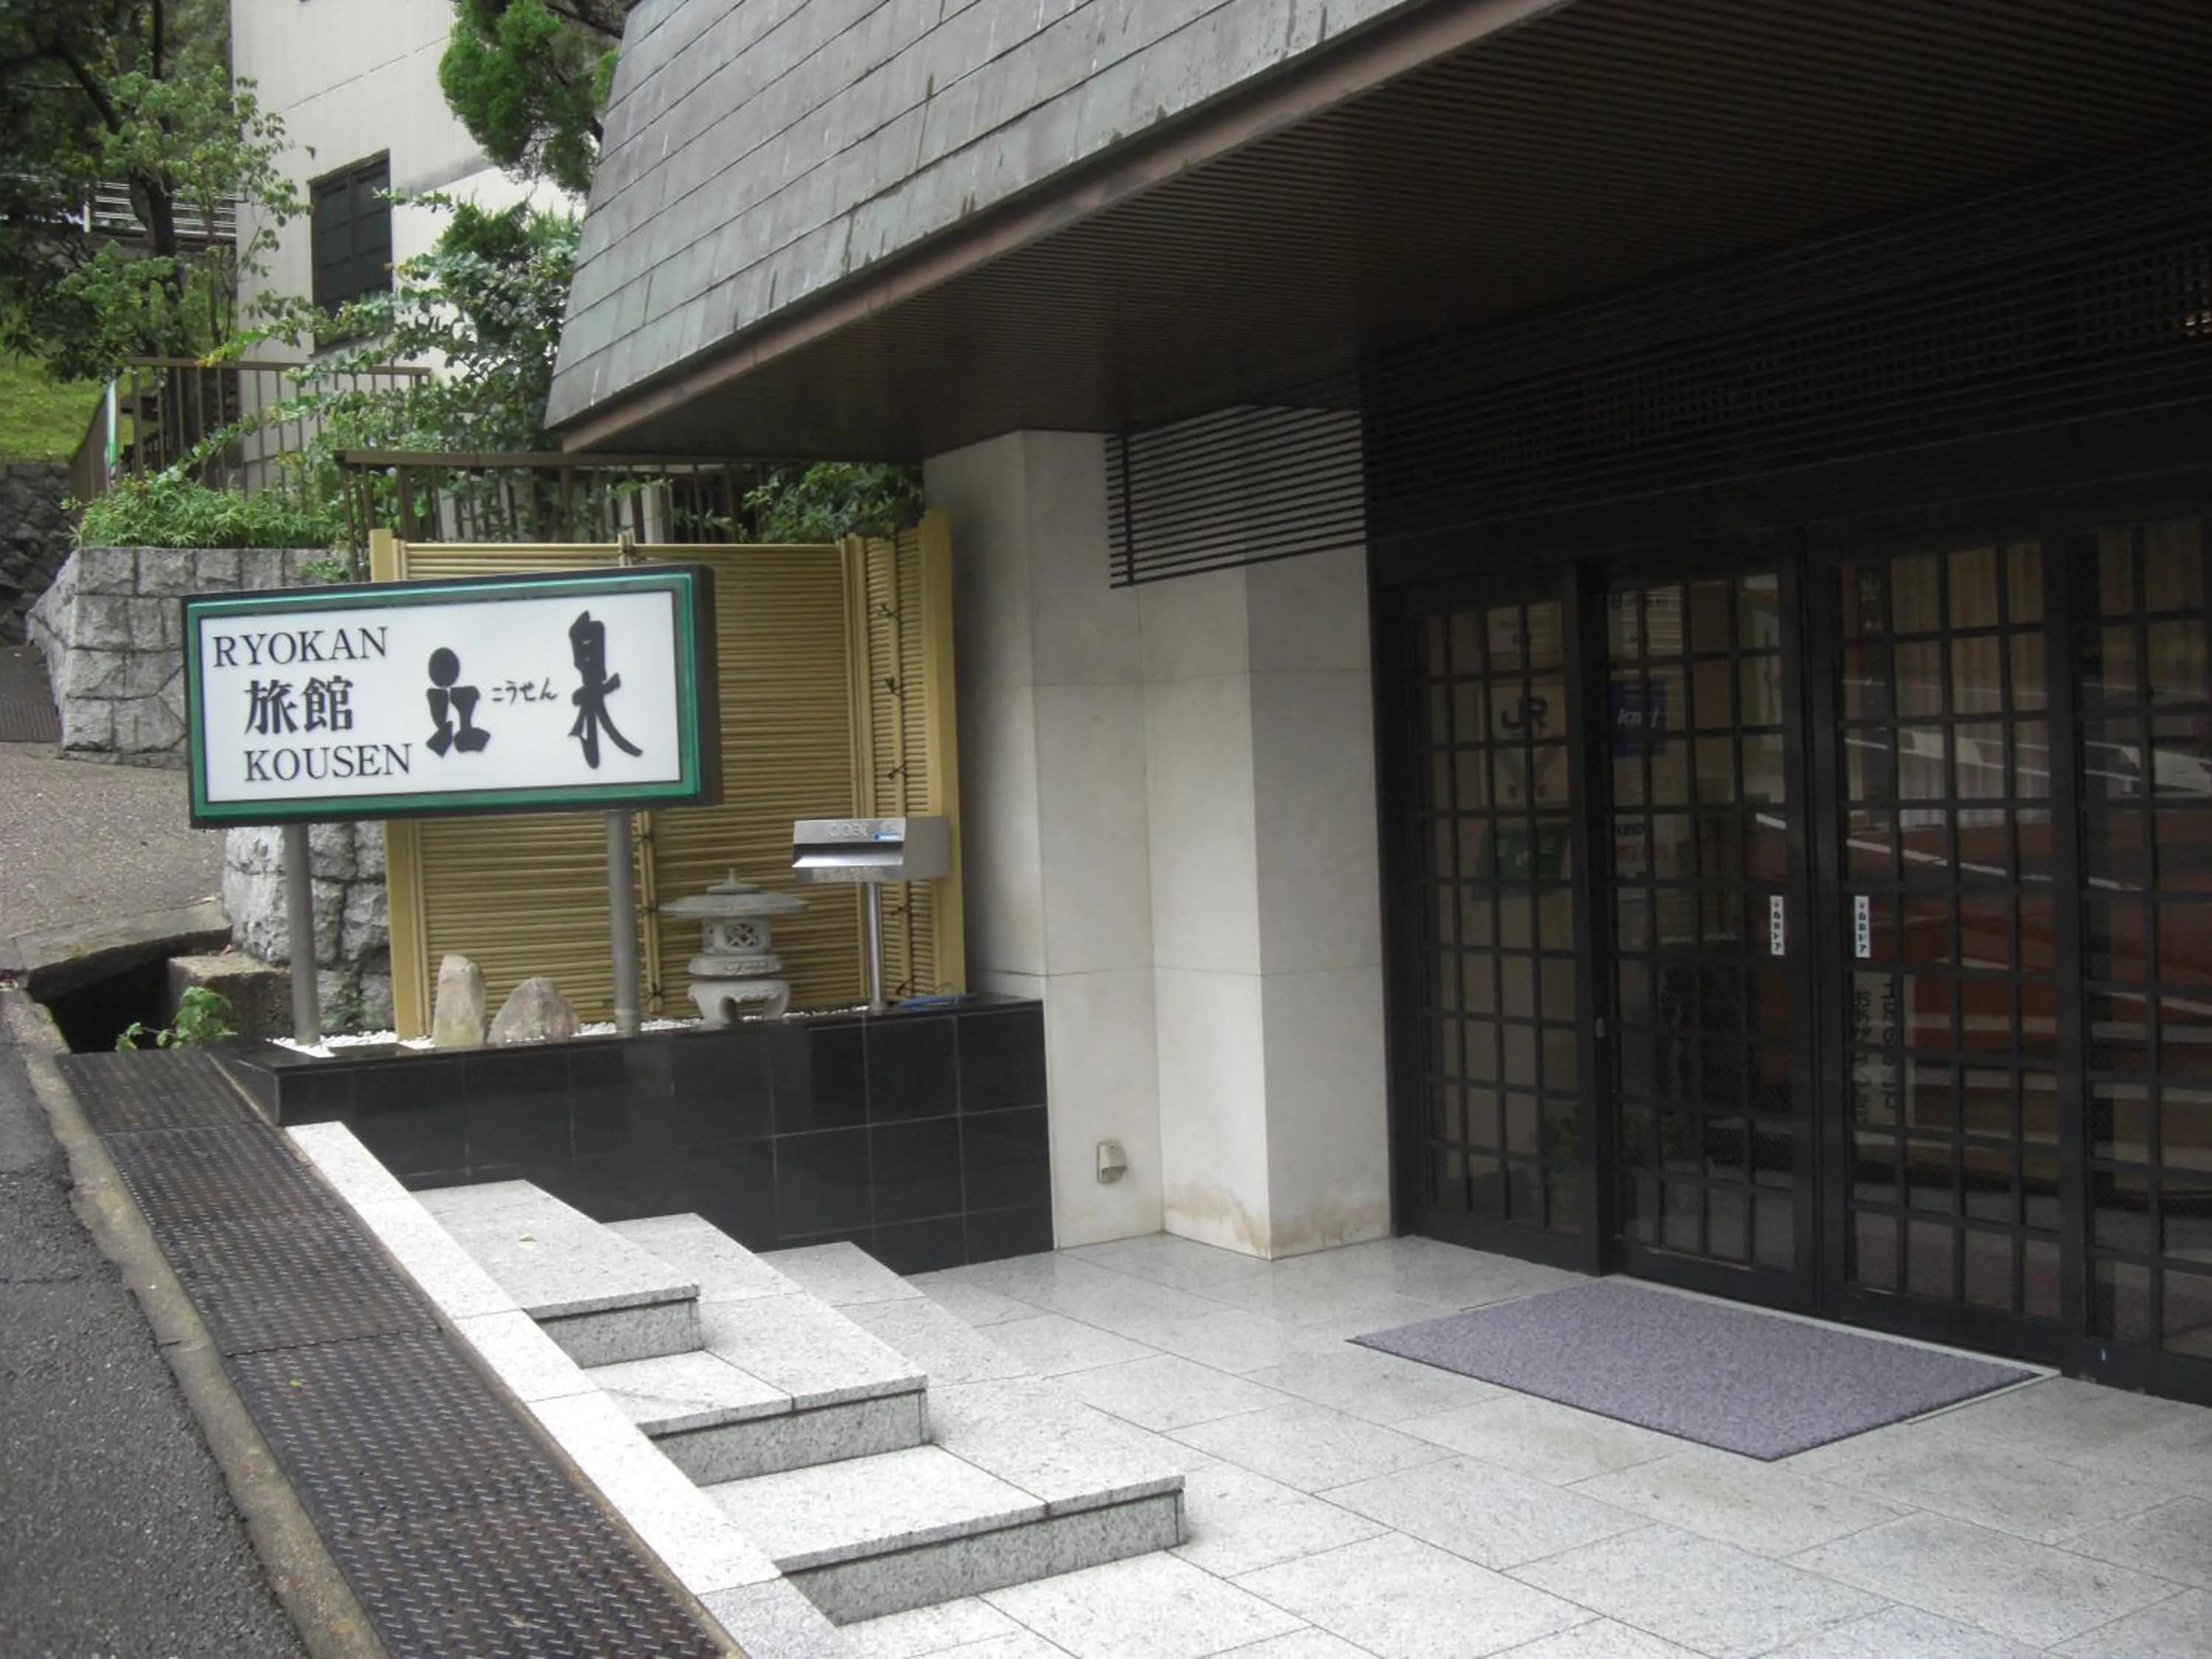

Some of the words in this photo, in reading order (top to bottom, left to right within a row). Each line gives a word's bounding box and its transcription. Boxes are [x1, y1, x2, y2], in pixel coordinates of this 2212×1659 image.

[212, 626, 389, 667] RYOKAN
[244, 675, 354, 735] 旅館
[492, 677, 557, 706] こうせん
[244, 743, 411, 782] KOUSEN
